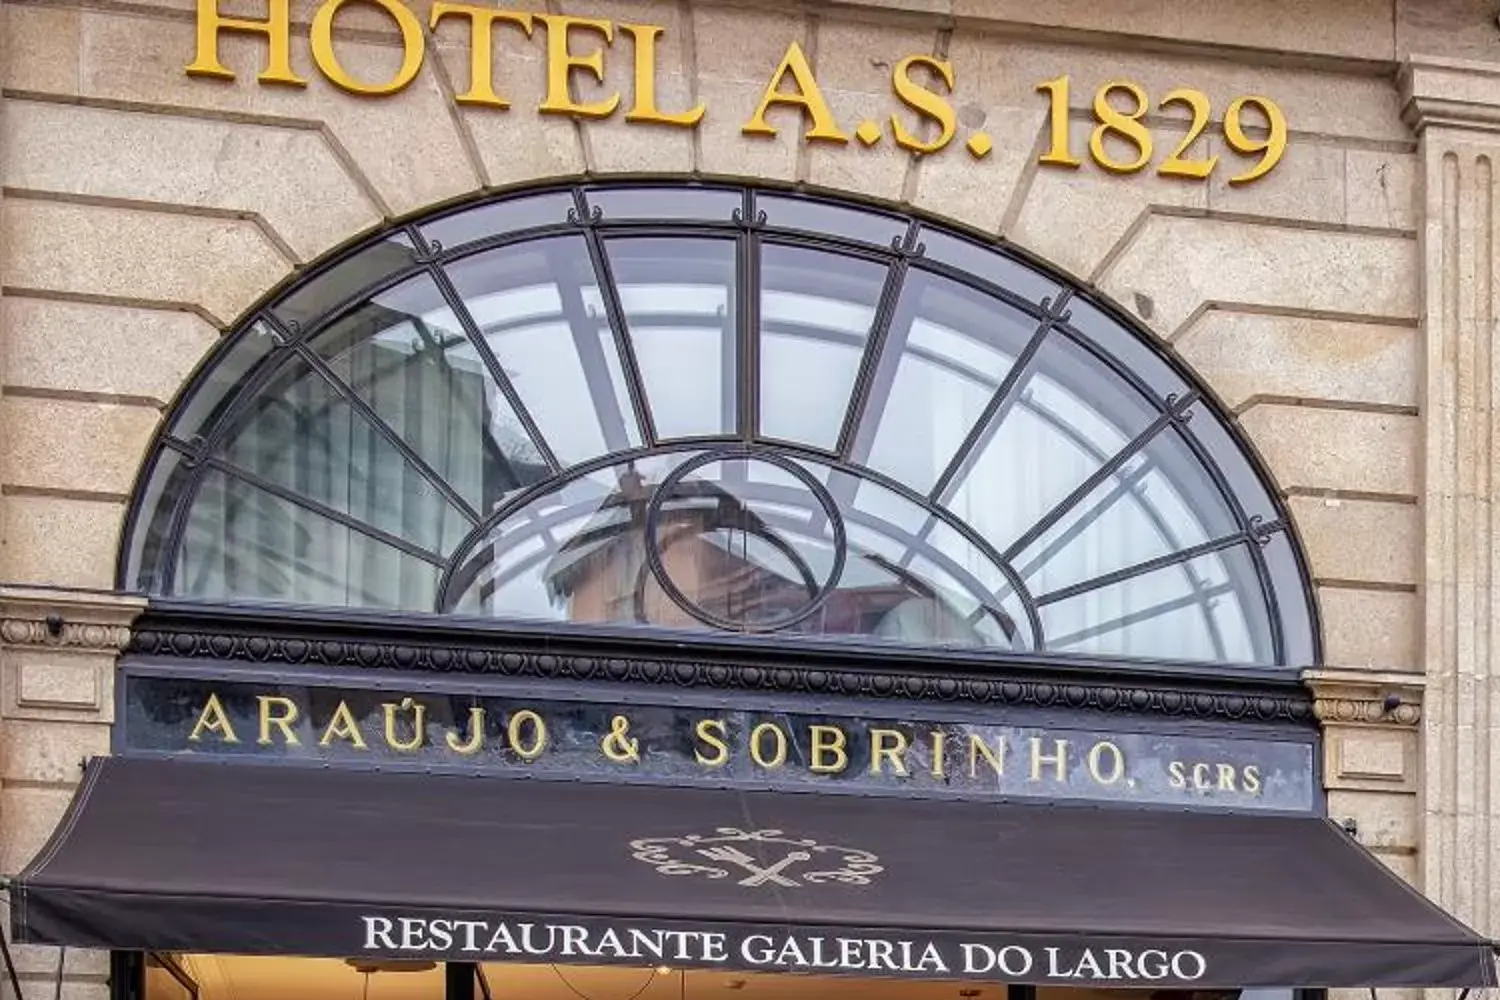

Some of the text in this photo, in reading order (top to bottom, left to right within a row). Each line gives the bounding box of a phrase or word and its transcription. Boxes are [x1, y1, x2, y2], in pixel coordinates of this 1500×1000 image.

[185, 0, 1289, 187] HOTEL A.S. 1829
[188, 692, 548, 760] ARAÚJO
[601, 714, 641, 764] &
[1168, 760, 1260, 793] SCRS
[363, 916, 1207, 980] RESTAURANTE GALERIA DO LARGO
